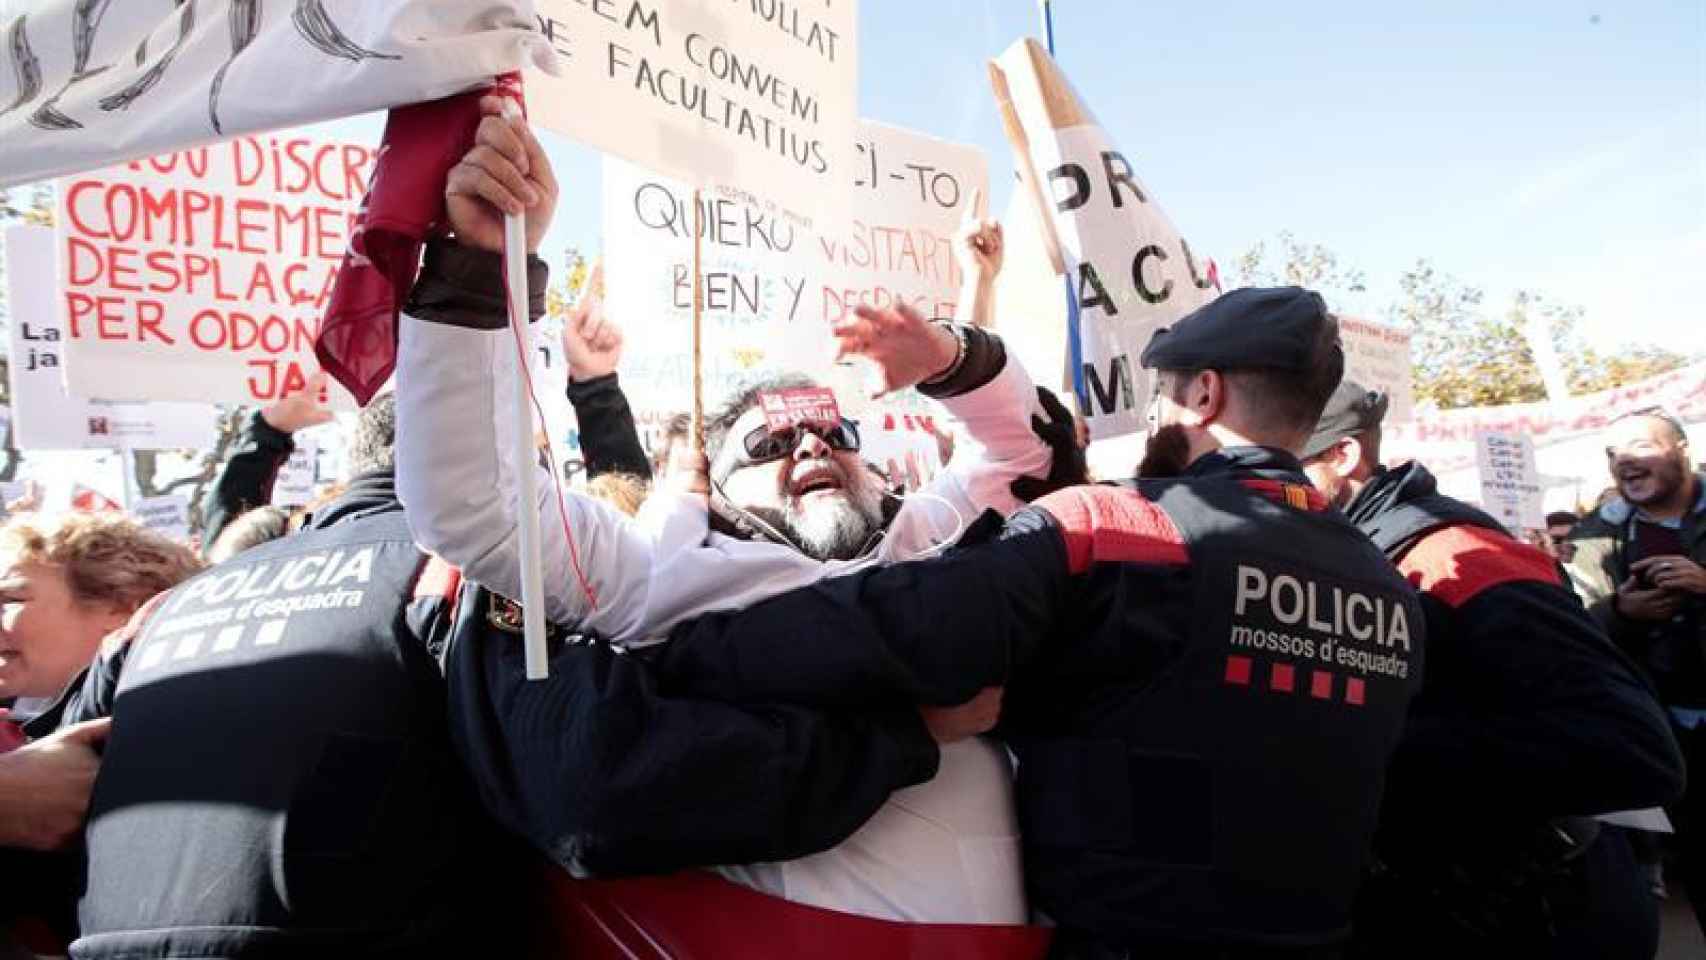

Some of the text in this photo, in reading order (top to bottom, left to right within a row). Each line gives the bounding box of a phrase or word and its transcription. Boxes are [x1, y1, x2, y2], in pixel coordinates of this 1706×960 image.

[608, 42, 828, 173] FACULTATIUS
[685, 33, 819, 123] CONVENI
[234, 137, 378, 199] DiSCR
[65, 292, 173, 345] PER
[673, 264, 759, 315] BEN
[784, 277, 805, 321] Y
[21, 322, 60, 342] La
[25, 349, 59, 372] ja
[171, 547, 374, 613] POLICIA
[1234, 565, 1410, 652] POLICIA
[1230, 625, 1315, 658] mossos
